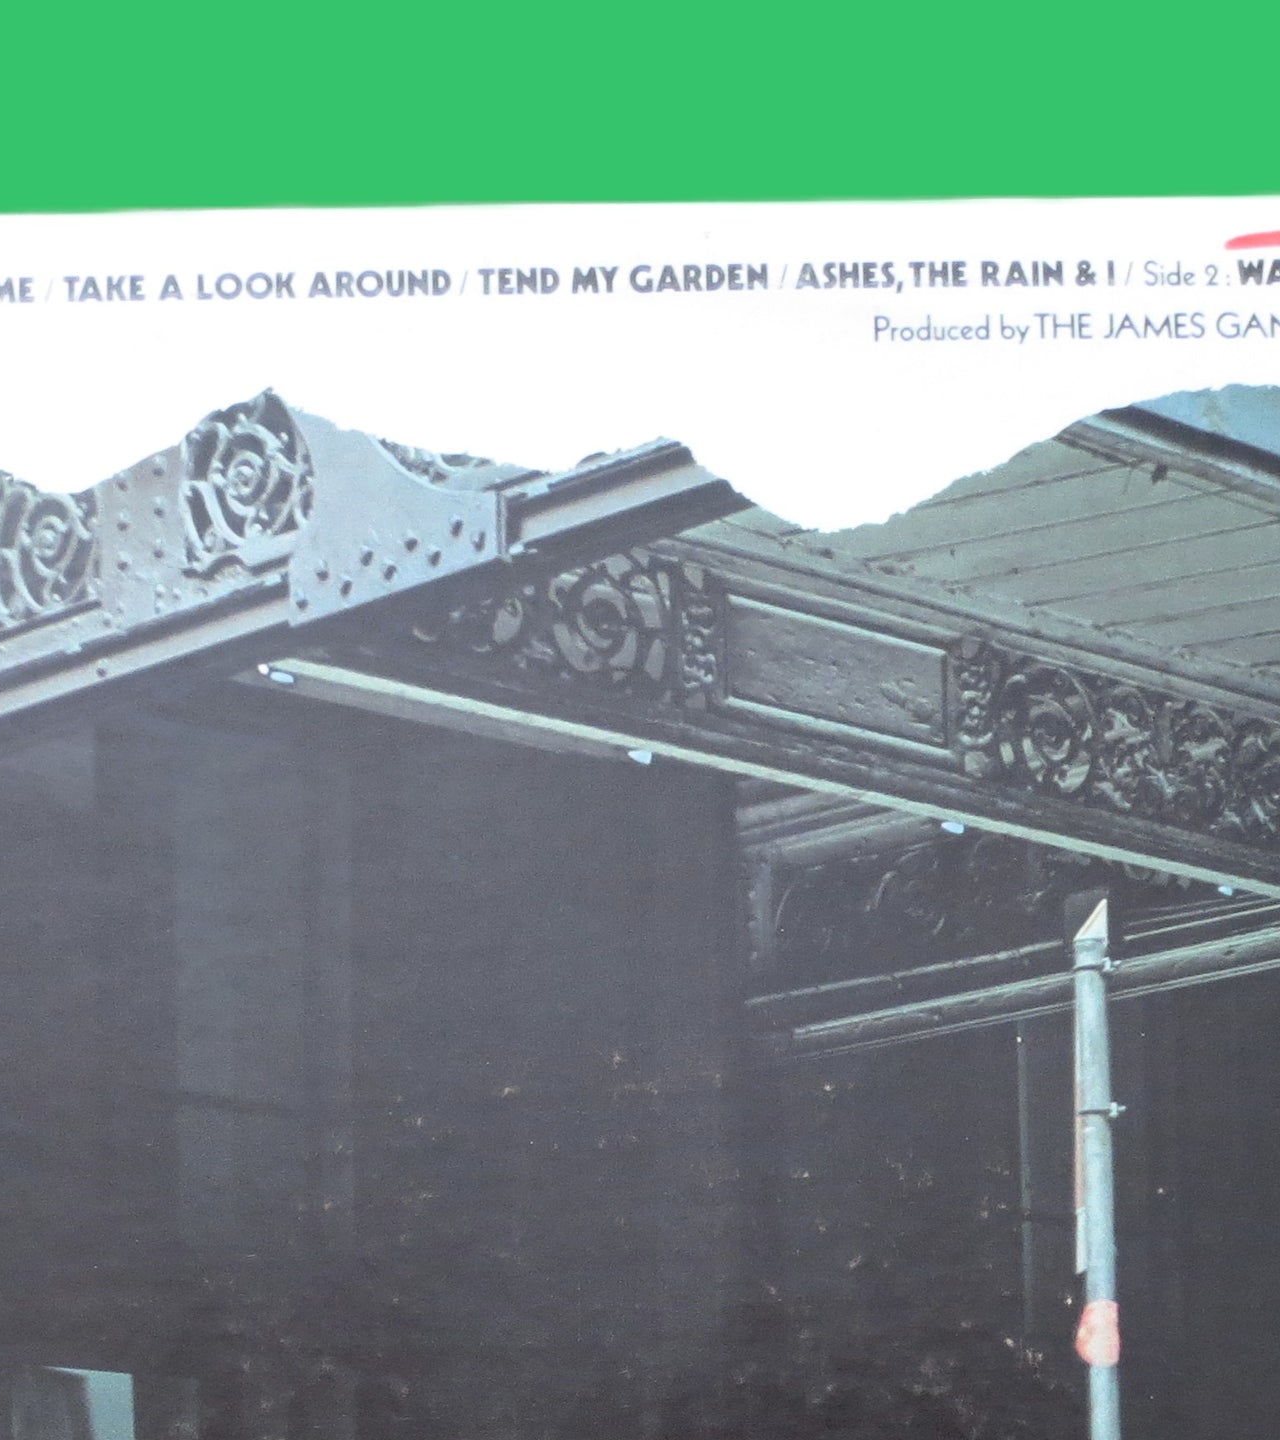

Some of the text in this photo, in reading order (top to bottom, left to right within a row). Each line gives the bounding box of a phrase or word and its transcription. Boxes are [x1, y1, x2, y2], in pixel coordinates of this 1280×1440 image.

[62, 275, 147, 303] TAKE
[158, 274, 184, 301] A
[195, 271, 297, 301] LOOK
[307, 268, 453, 299] AROUND
[478, 267, 560, 296] TEND
[570, 266, 620, 295] MY
[628, 262, 769, 294] GARDEN
[980, 260, 1065, 288] RAIN
[1074, 260, 1098, 287] &
[1106, 259, 1116, 287] I
[1143, 258, 1197, 287] Side
[873, 314, 991, 343] Produced
[1000, 313, 1030, 345] by
[1032, 312, 1093, 339] THE
[1103, 312, 1207, 340] JAMES
